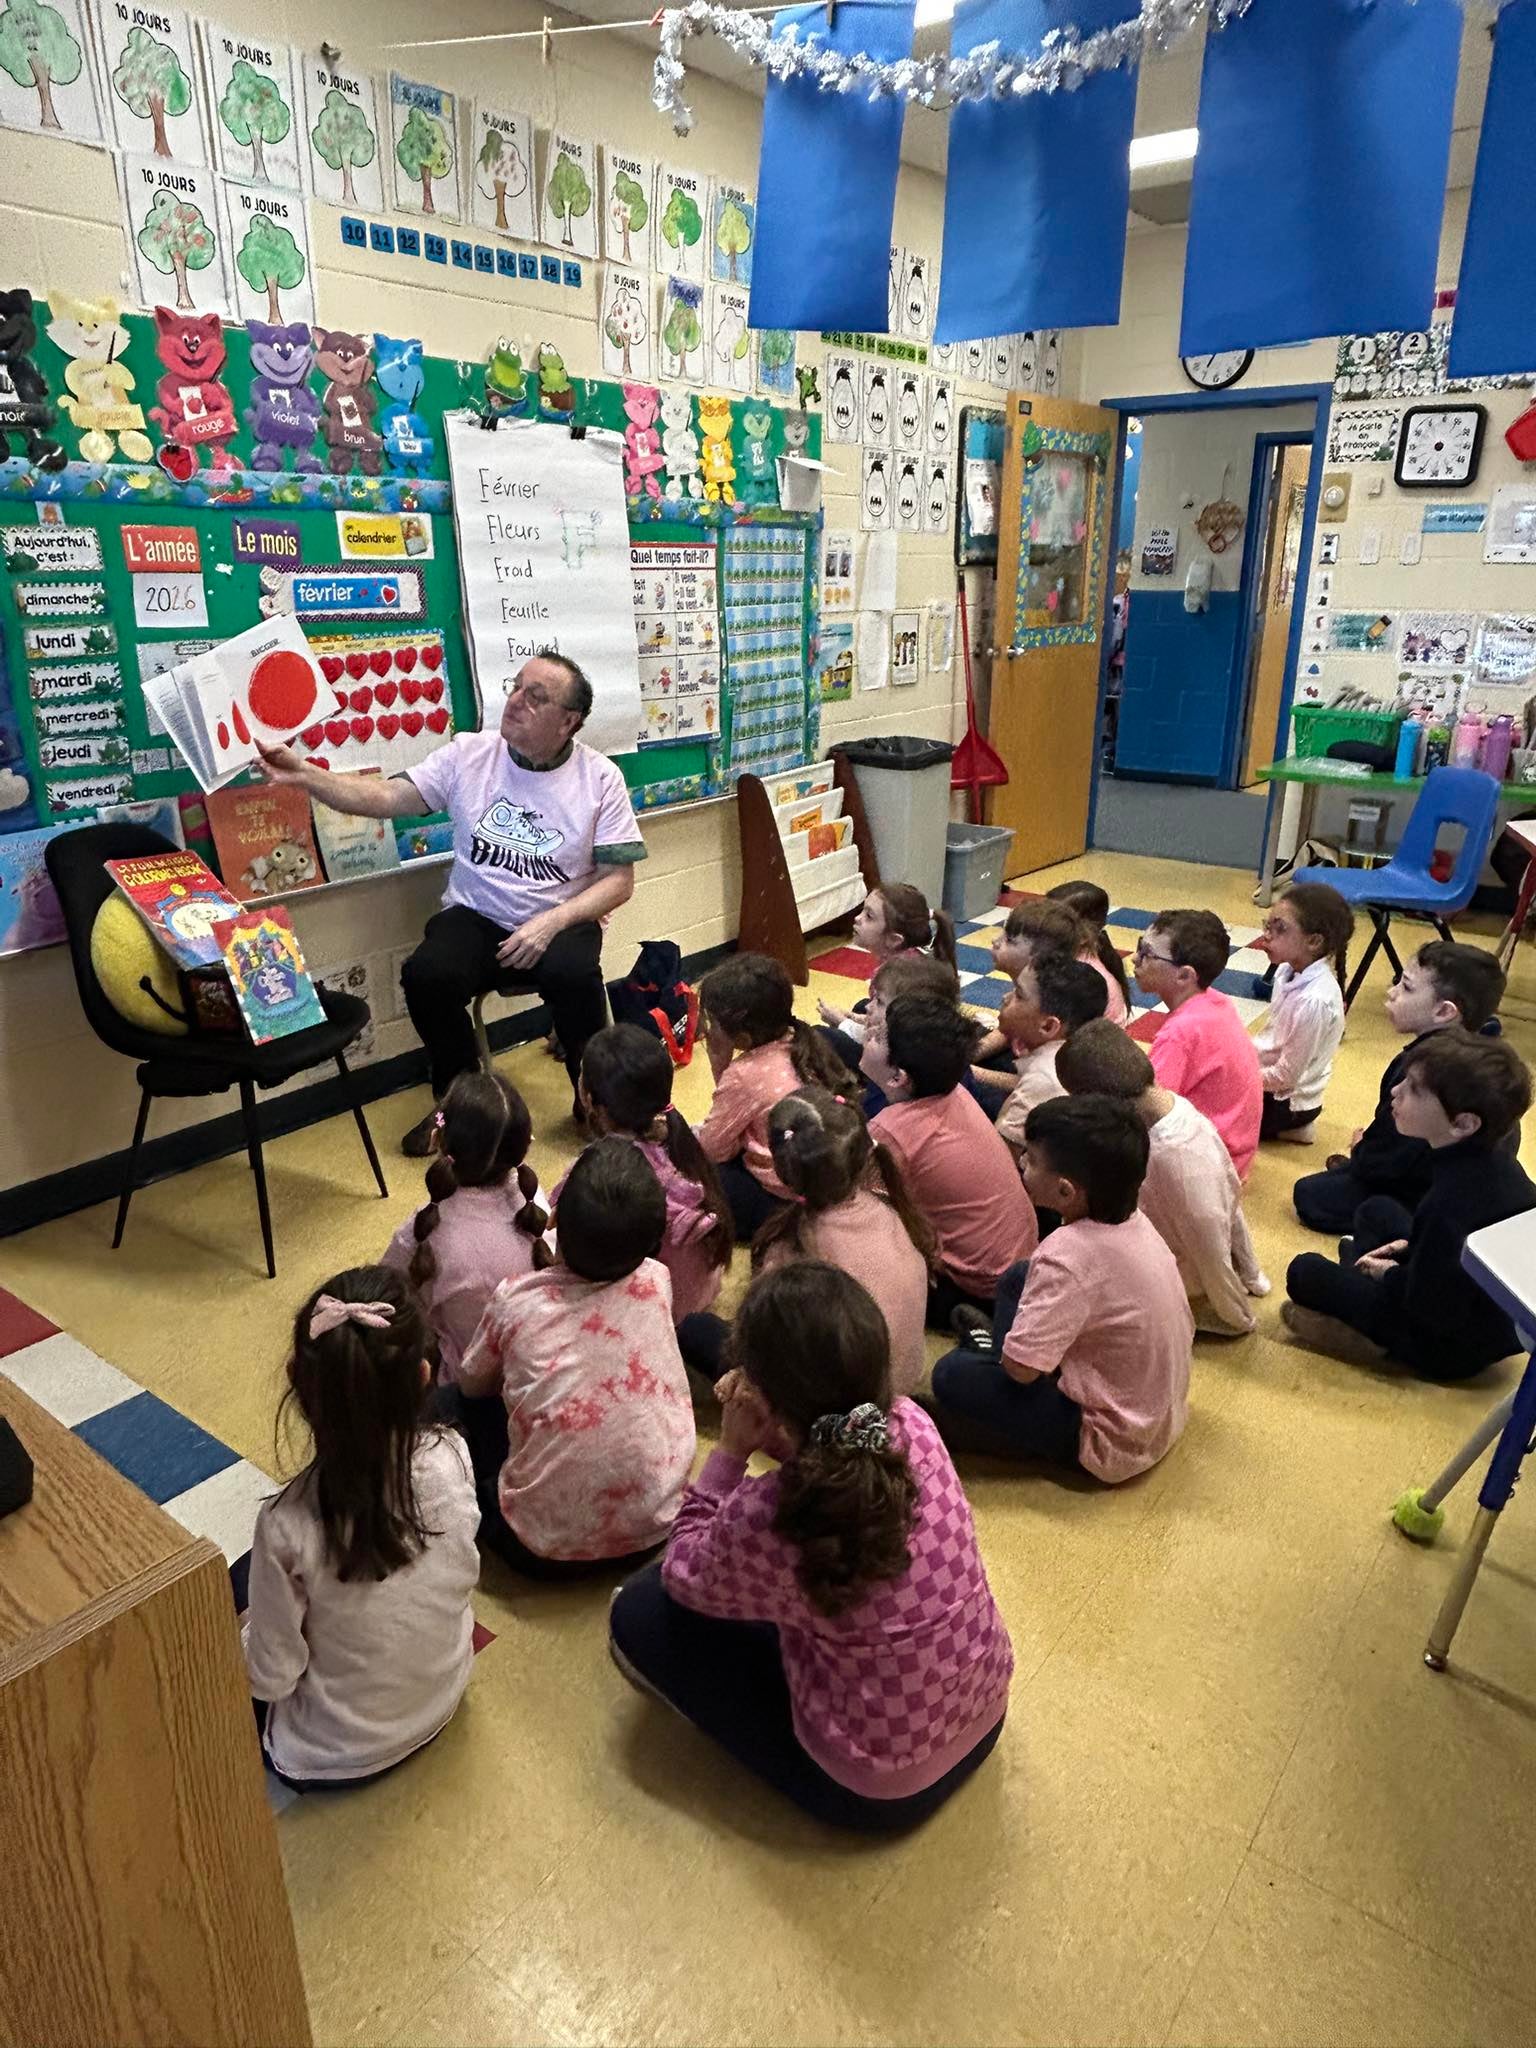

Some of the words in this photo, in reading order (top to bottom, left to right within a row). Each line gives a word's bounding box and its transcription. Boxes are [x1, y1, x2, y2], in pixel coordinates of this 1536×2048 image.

[115, 3, 128, 20] 10
[132, 9, 171, 33] JOURS
[222, 39, 233, 54] 10
[236, 42, 272, 66] JOURS
[317, 70, 327, 85] 10
[330, 76, 360, 95] JOURS
[490, 116, 516, 134] JOURS
[618, 158, 642, 175] JOURS
[141, 168, 154, 184] 10
[158, 172, 196, 193] JOURS
[674, 176, 697, 191] JOURS
[240, 195, 251, 209] 10
[254, 199, 289, 218] JOURS
[345, 223, 364, 240] 10
[373, 230, 391, 247] 11
[399, 233, 416, 250] 12
[427, 239, 444, 256] 13
[454, 245, 471, 263] 14
[478, 252, 492, 267] 15
[500, 255, 515, 270] 16
[521, 260, 534, 274] 17
[543, 262, 557, 276] 18
[566, 266, 580, 281] 19
[613, 273, 620, 286] 10
[620, 276, 640, 291] JOURS
[1410, 335, 1419, 347] 2
[192, 418, 224, 434] rouge
[271, 410, 300, 426] violet
[344, 431, 365, 444] brun
[478, 468, 540, 500] Février
[487, 514, 541, 542] Fleurs
[14, 536, 90, 550] Aujourd'hui,
[236, 525, 256, 553] Le
[260, 530, 297, 557] mois
[347, 531, 397, 544] calendrier
[36, 551, 68, 562] c'est
[128, 533, 197, 563] L'année
[631, 549, 652, 563] Quel
[655, 550, 681, 565] temps
[683, 550, 709, 563] fait-il?
[494, 557, 533, 580] Froid
[26, 593, 90, 606] dimanche
[145, 586, 196, 613] 2026
[297, 582, 354, 603] février
[501, 598, 550, 622] Feuille
[35, 633, 76, 650] lundi
[41, 671, 92, 690] mardi
[46, 708, 110, 725] mercredi
[50, 743, 92, 764] jeudi
[57, 783, 116, 801] vendredi
